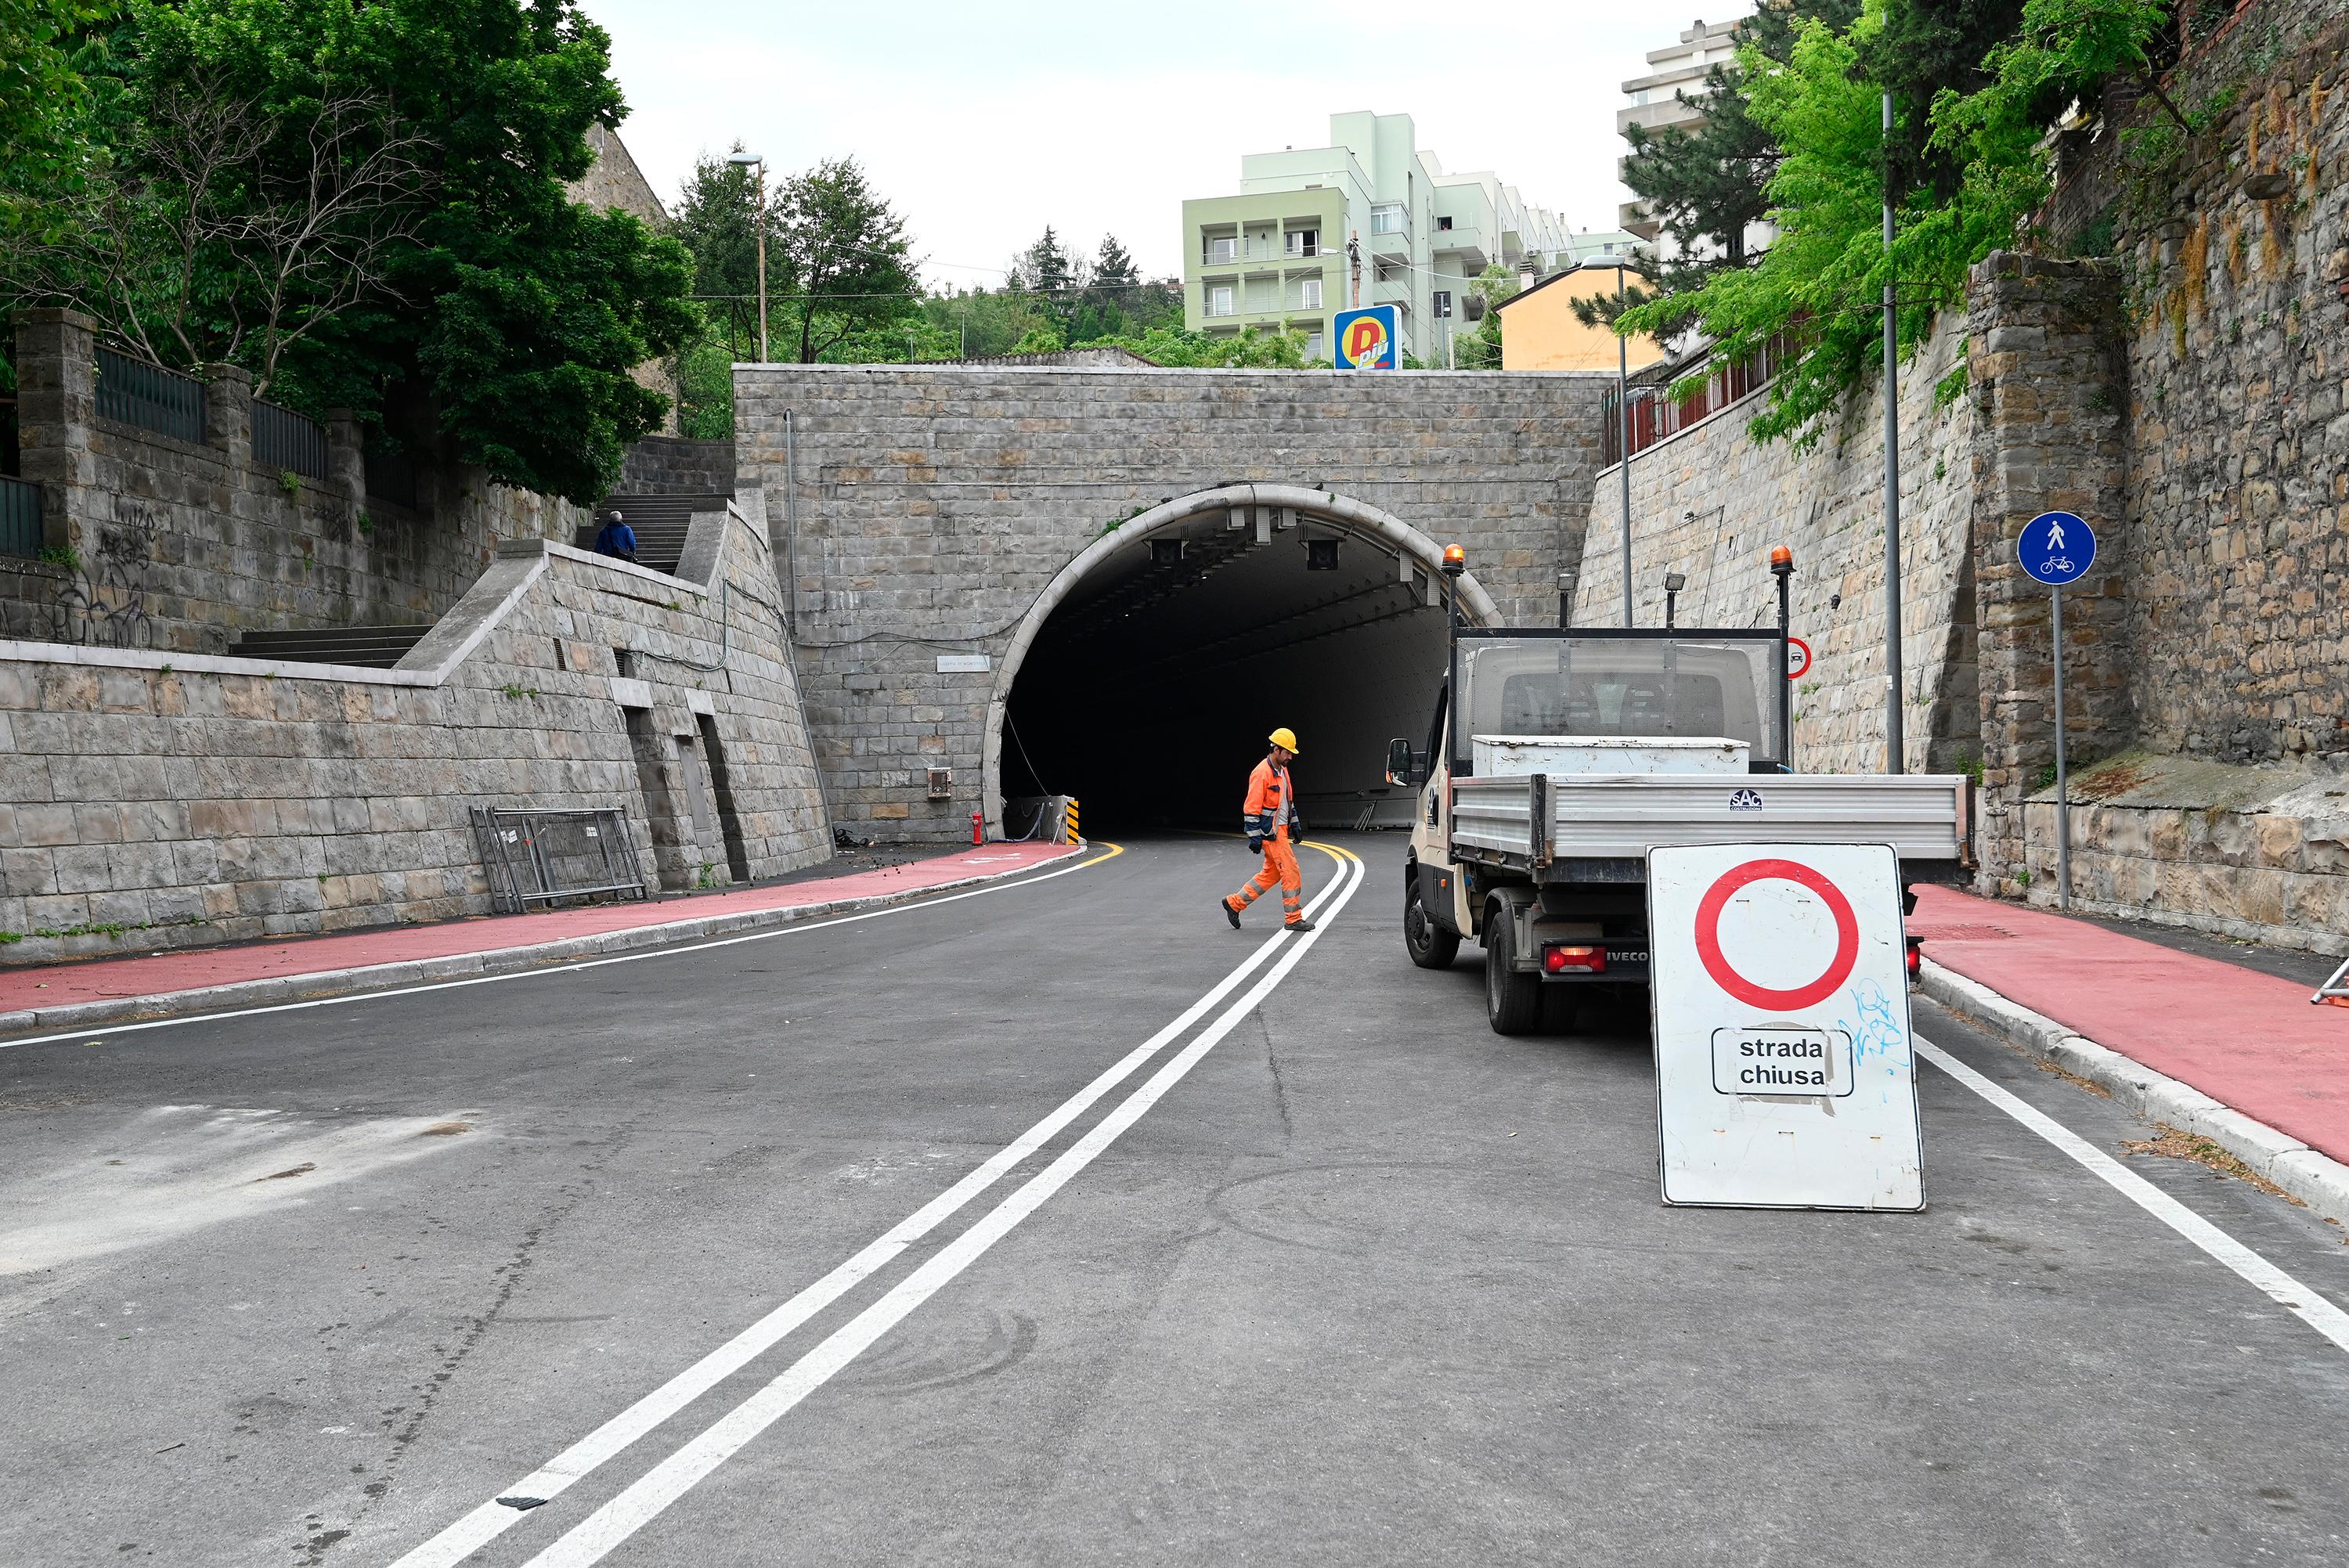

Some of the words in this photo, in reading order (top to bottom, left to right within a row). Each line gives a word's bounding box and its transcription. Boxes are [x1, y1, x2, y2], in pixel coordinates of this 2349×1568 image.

[1731, 789, 1760, 806] SAC
[1607, 952, 1648, 961] IVECO
[1740, 1039, 1823, 1058] strada
[1740, 1065, 1825, 1085] chiusa
